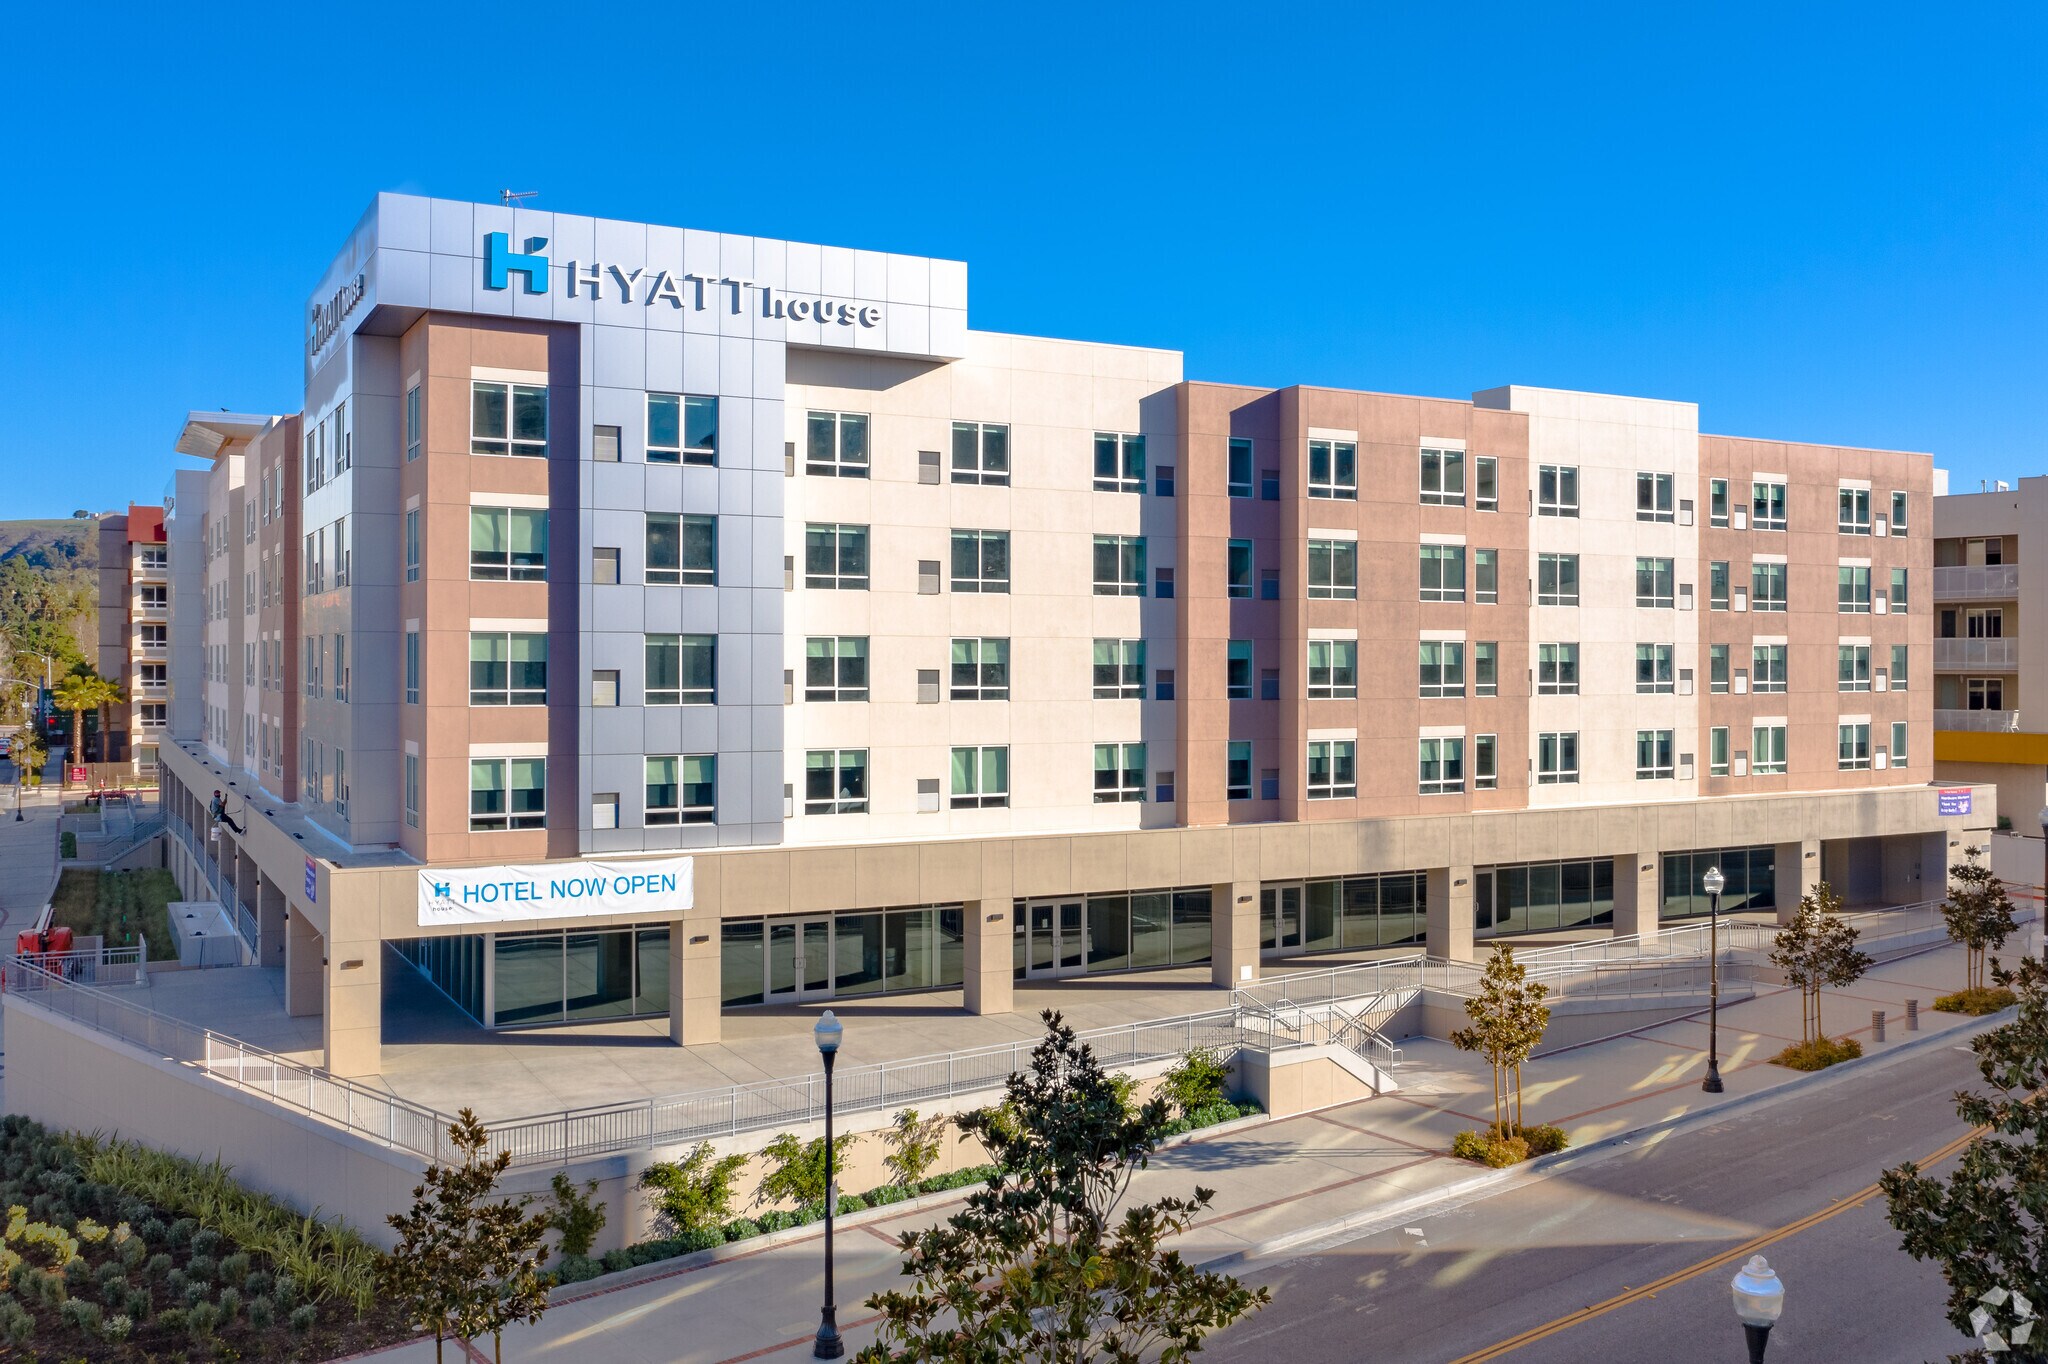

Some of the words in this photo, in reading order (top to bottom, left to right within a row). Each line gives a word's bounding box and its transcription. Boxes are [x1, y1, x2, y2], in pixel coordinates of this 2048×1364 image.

[568, 260, 755, 315] HYATT
[762, 286, 883, 328] house
[463, 881, 543, 904] HOTEL
[550, 877, 607, 899] NOW
[613, 873, 676, 895] OPEN
